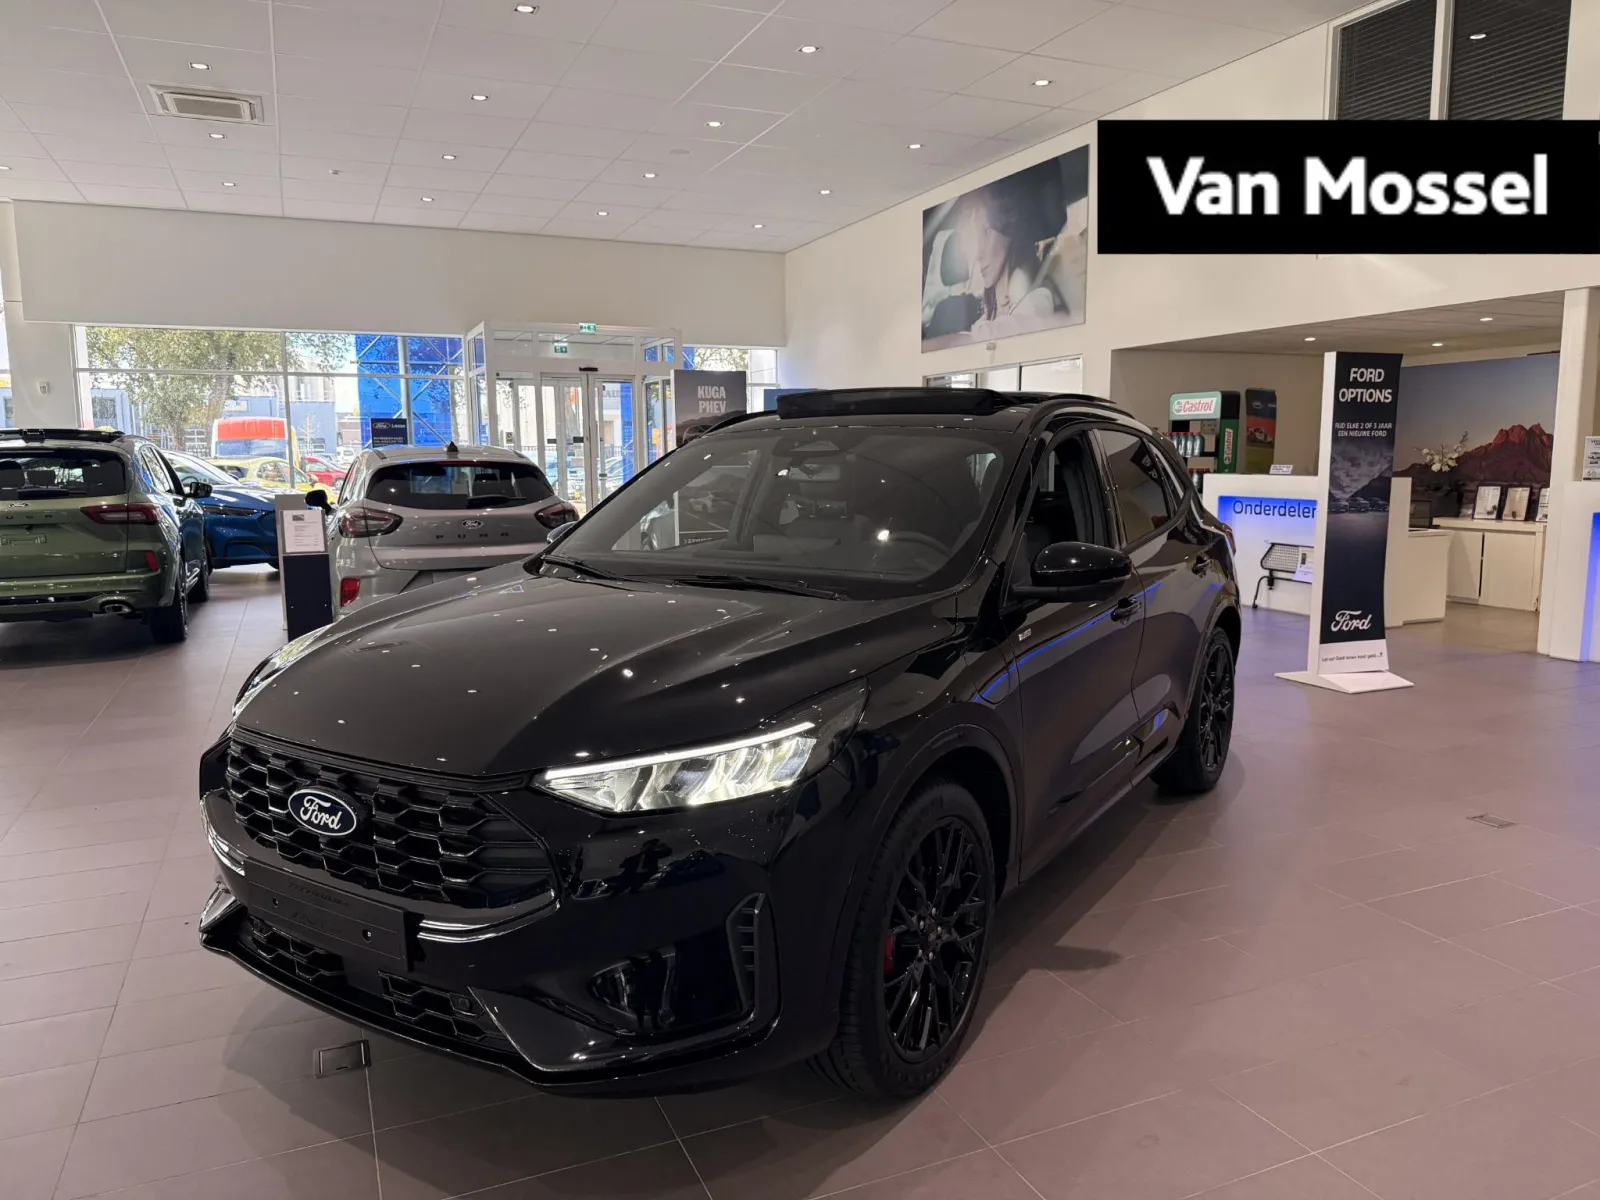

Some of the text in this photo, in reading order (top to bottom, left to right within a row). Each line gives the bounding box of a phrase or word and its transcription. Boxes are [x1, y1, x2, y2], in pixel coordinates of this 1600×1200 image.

[1349, 367, 1385, 383] FORD
[697, 385, 726, 399] KUGA
[1338, 387, 1393, 403] OPTIONS
[698, 400, 727, 414] PHEV
[1182, 399, 1214, 413] Castrol
[1377, 422, 1393, 430] JAAR
[1224, 430, 1233, 457] Castrol
[1330, 610, 1372, 632] Ford
[300, 795, 342, 830] Ford
